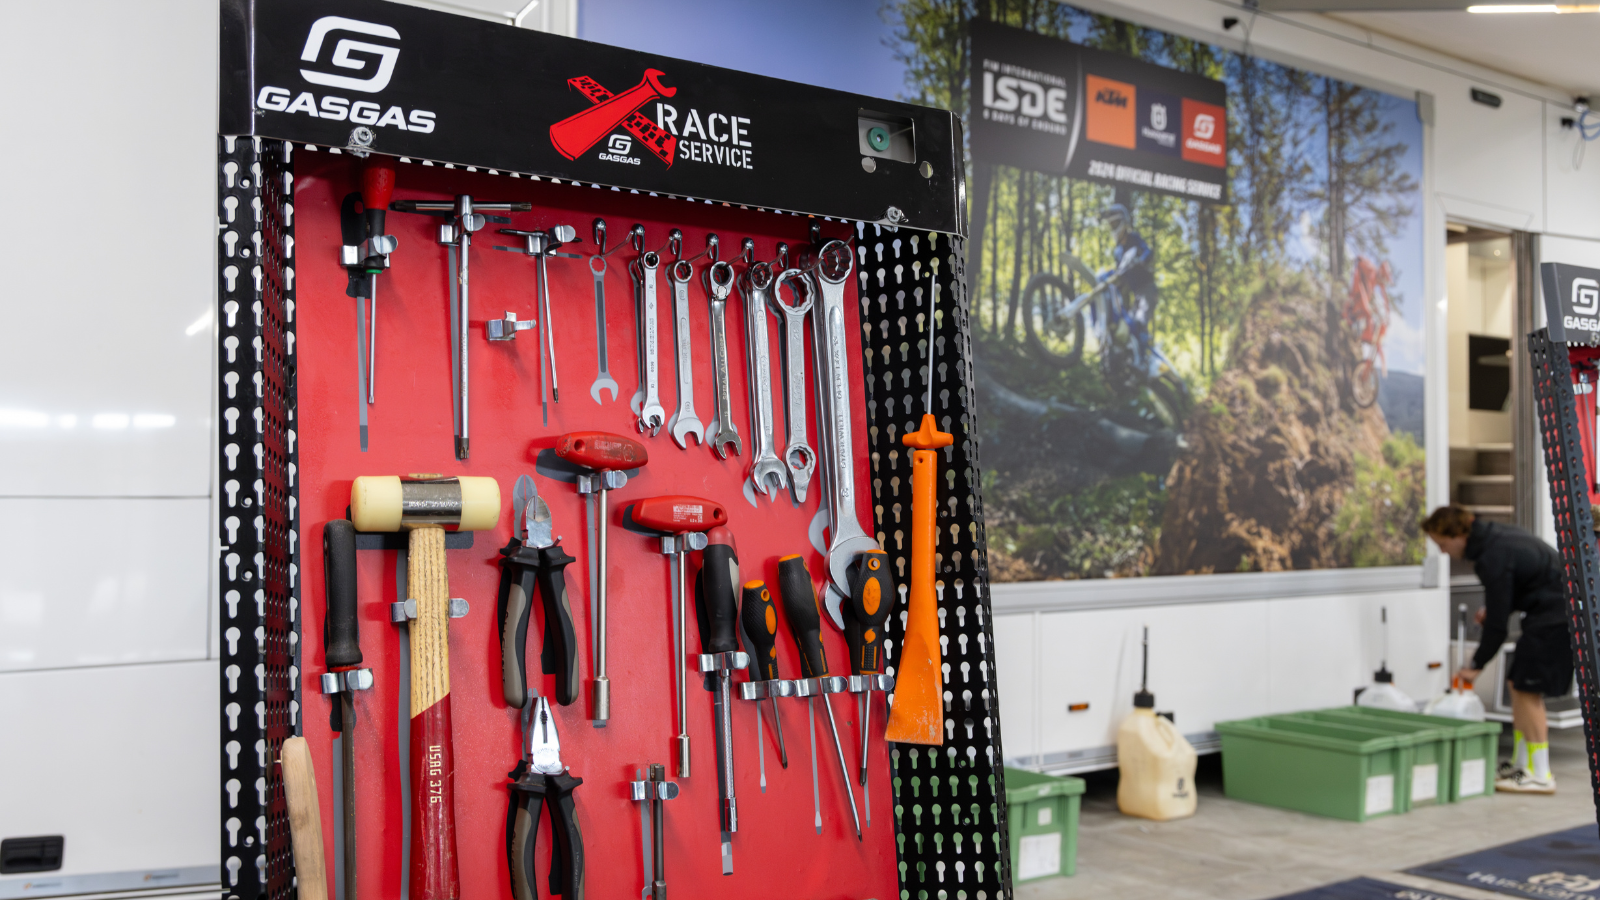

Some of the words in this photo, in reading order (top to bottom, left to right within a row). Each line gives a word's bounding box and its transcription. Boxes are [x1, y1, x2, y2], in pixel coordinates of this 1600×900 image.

[256, 86, 437, 134] GASGAS
[983, 71, 1067, 125] ISDE
[1095, 89, 1128, 109] KTM
[656, 102, 752, 148] RACE
[598, 152, 641, 166] GASGAS
[679, 139, 753, 170] SERVICE
[1564, 316, 1600, 332] GASG
[429, 745, 442, 776] USAG
[429, 779, 442, 804] 376
